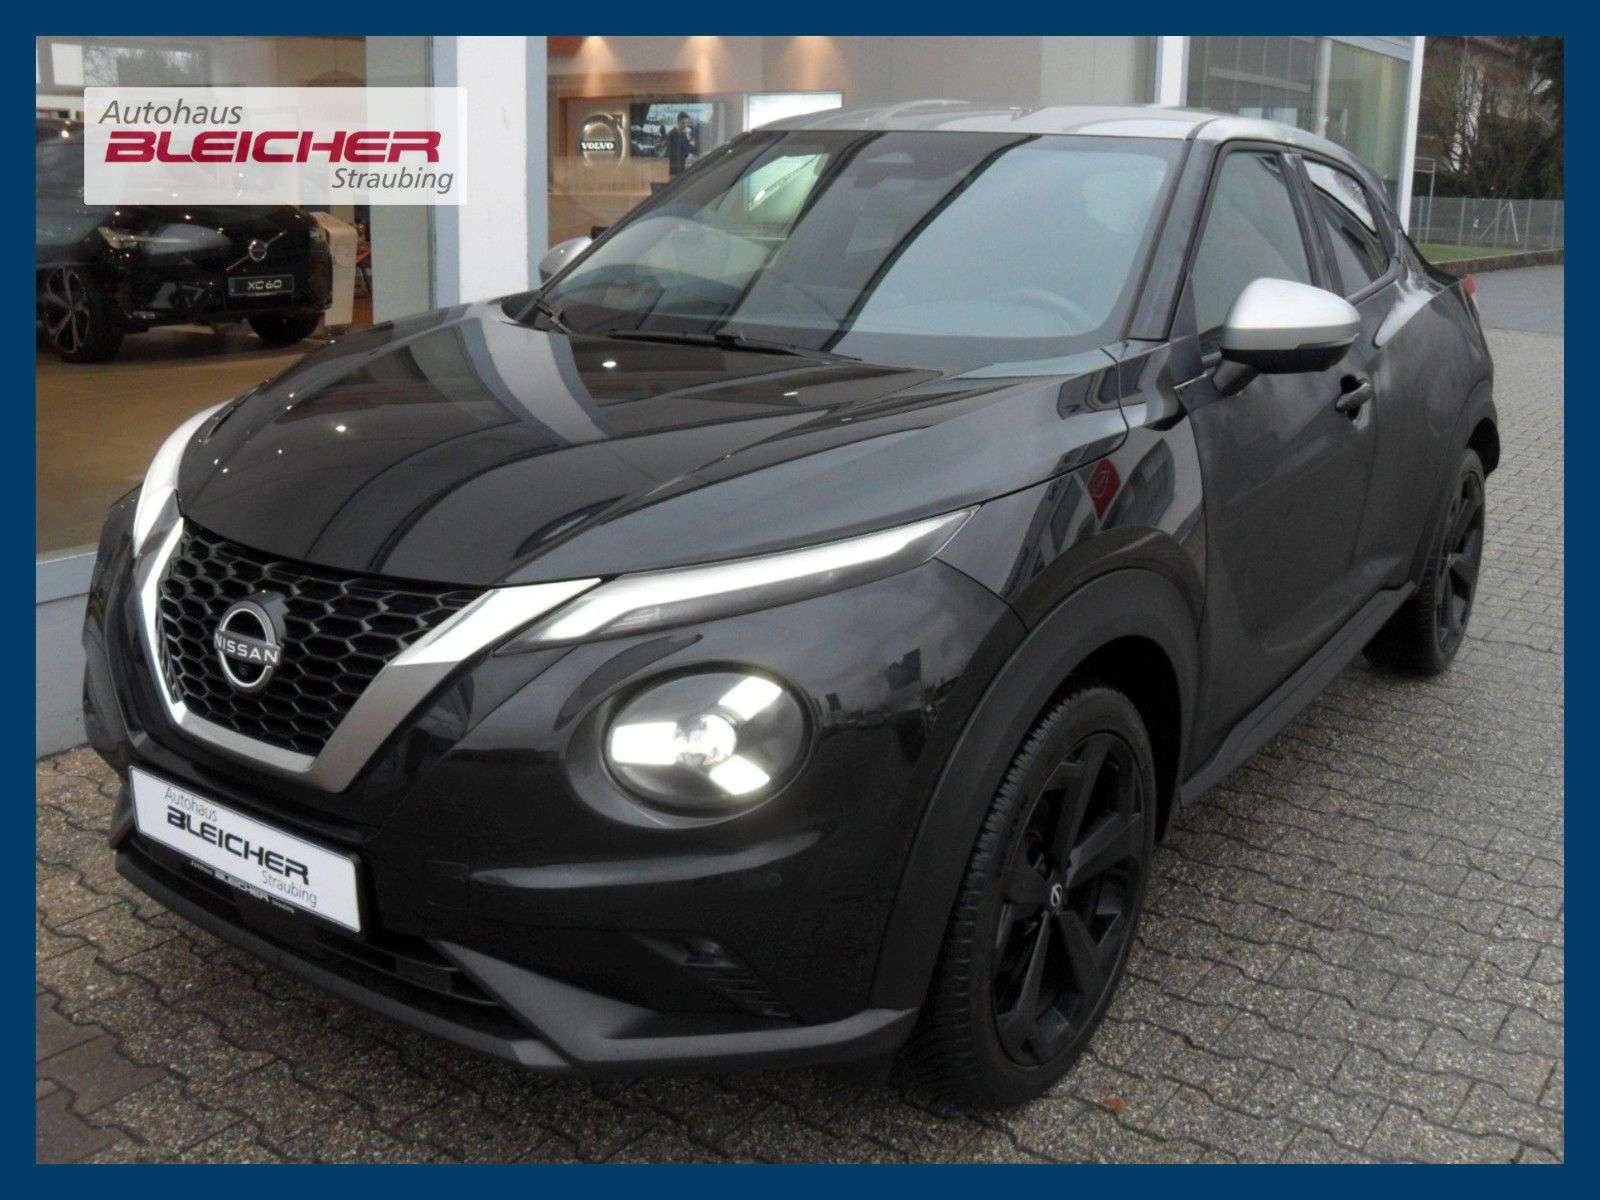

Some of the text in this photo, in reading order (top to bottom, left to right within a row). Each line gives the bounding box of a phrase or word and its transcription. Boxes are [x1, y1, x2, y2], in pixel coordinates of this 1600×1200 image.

[581, 142, 614, 151] VOLVO
[214, 632, 278, 663] NISSAN
[163, 787, 218, 823] Autohaus
[167, 805, 310, 885] BLEICHER
[261, 869, 318, 908] Straubing
